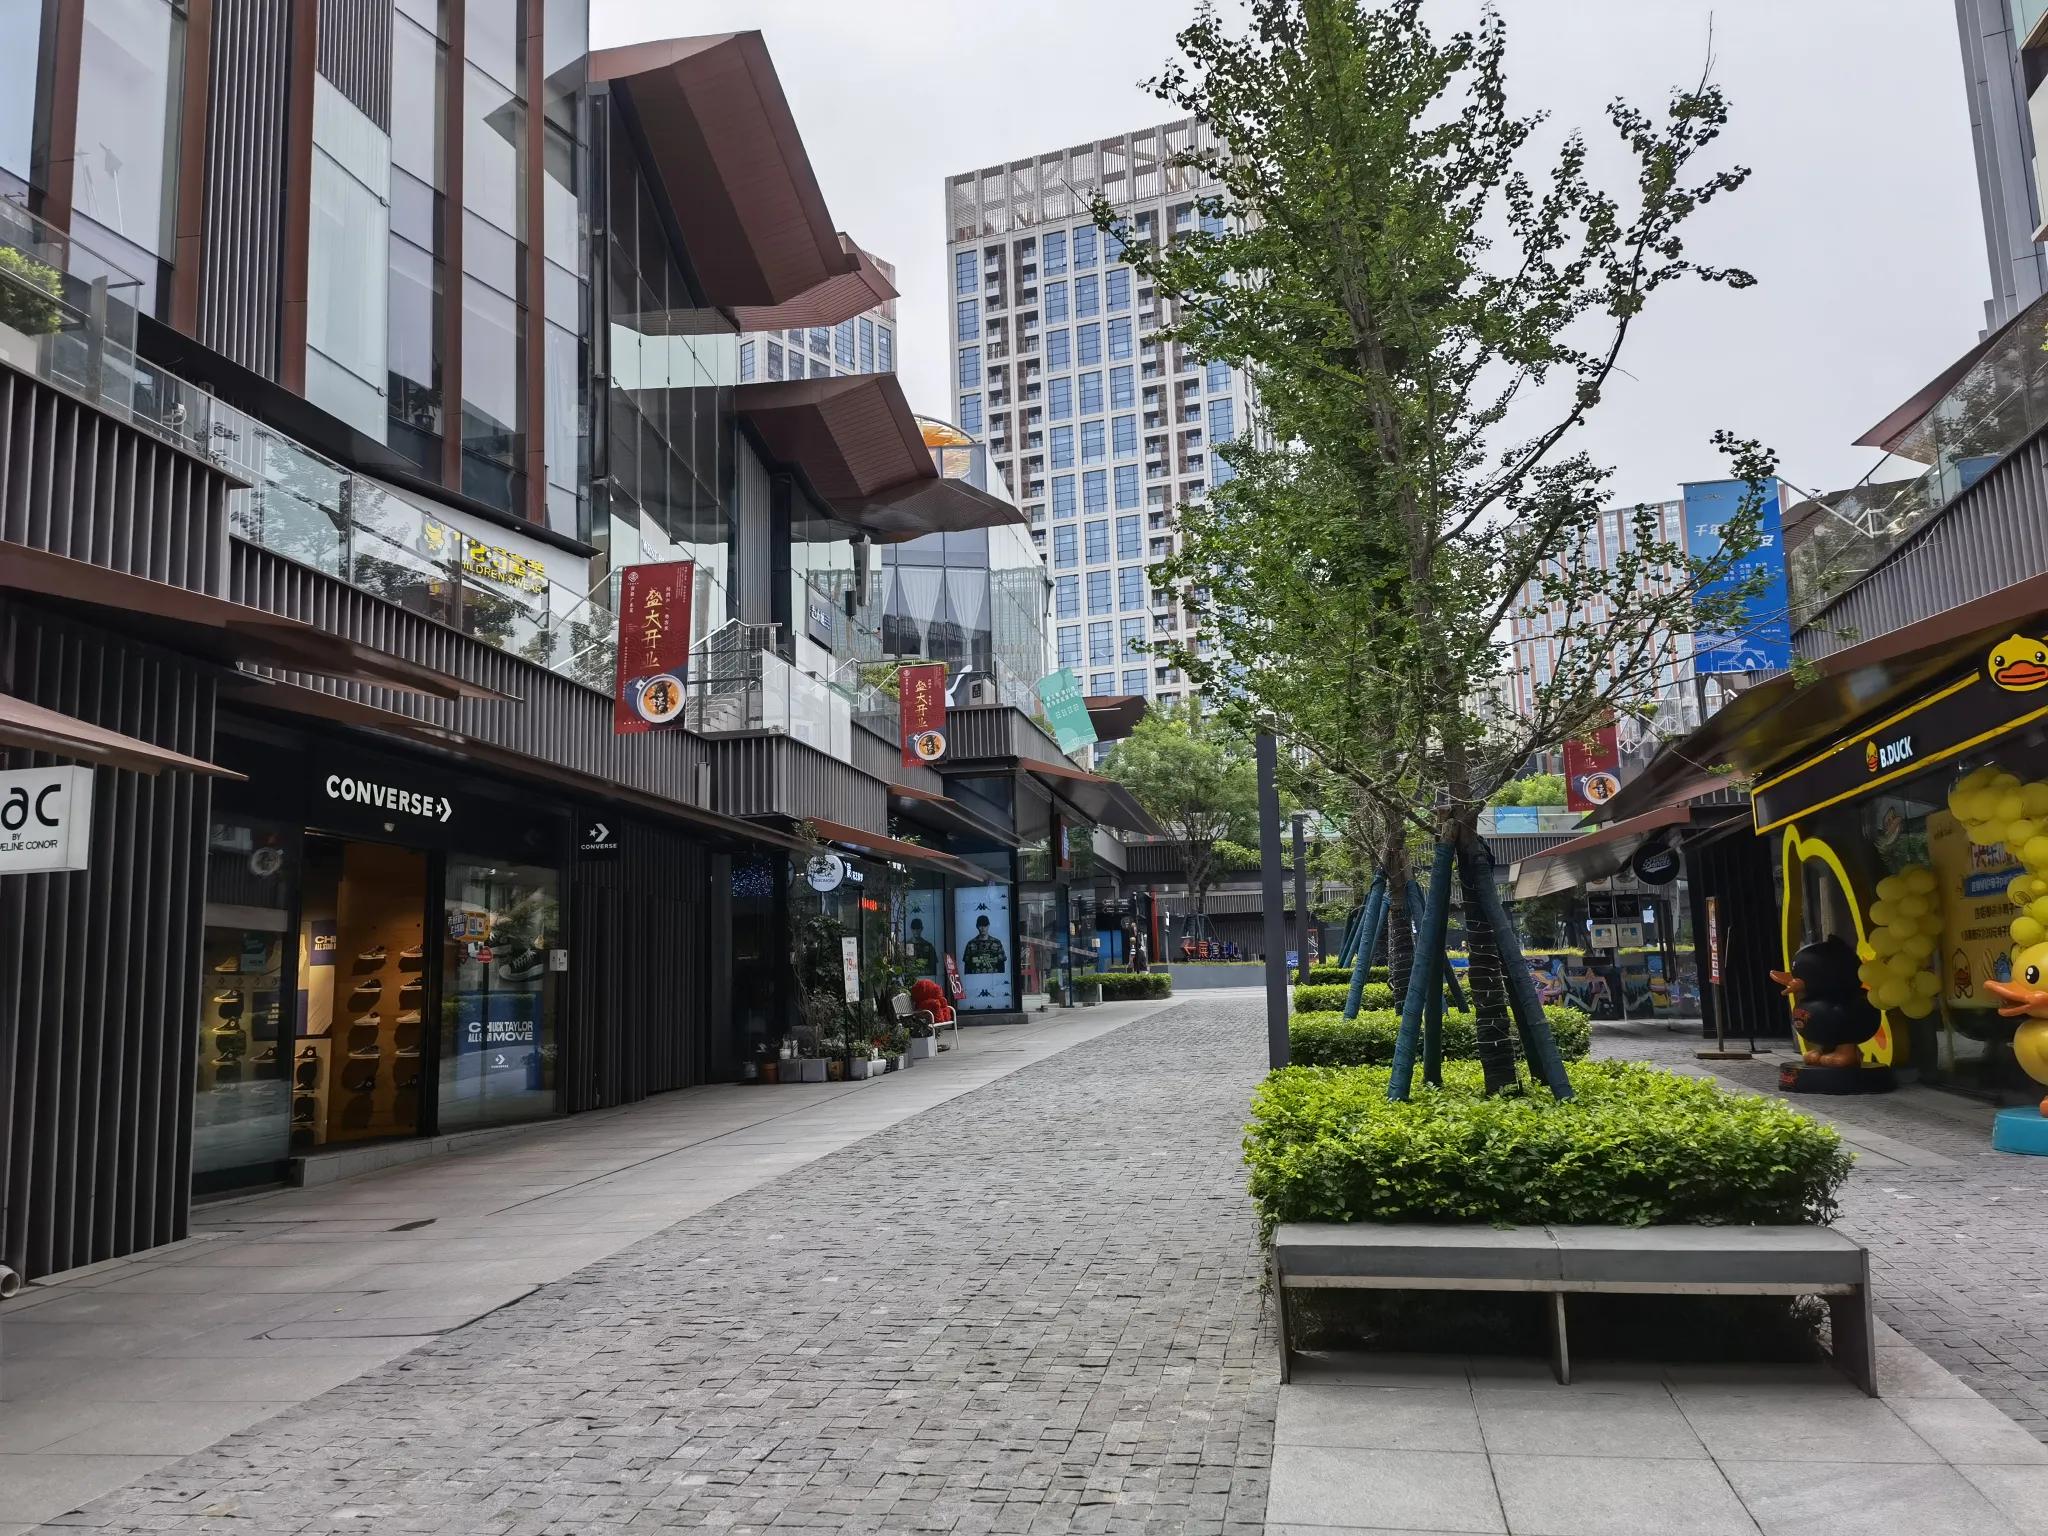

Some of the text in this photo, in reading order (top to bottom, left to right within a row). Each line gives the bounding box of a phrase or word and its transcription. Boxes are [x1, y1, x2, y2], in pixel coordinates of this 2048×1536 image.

[640, 587, 664, 668] 盛大开业
[1879, 736, 1913, 768] B.DUCK
[326, 775, 434, 818] CONVERSE
[12, 833, 21, 841] BY
[493, 1032, 533, 1042] MOVE
[504, 1021, 533, 1032] TAYLOR
